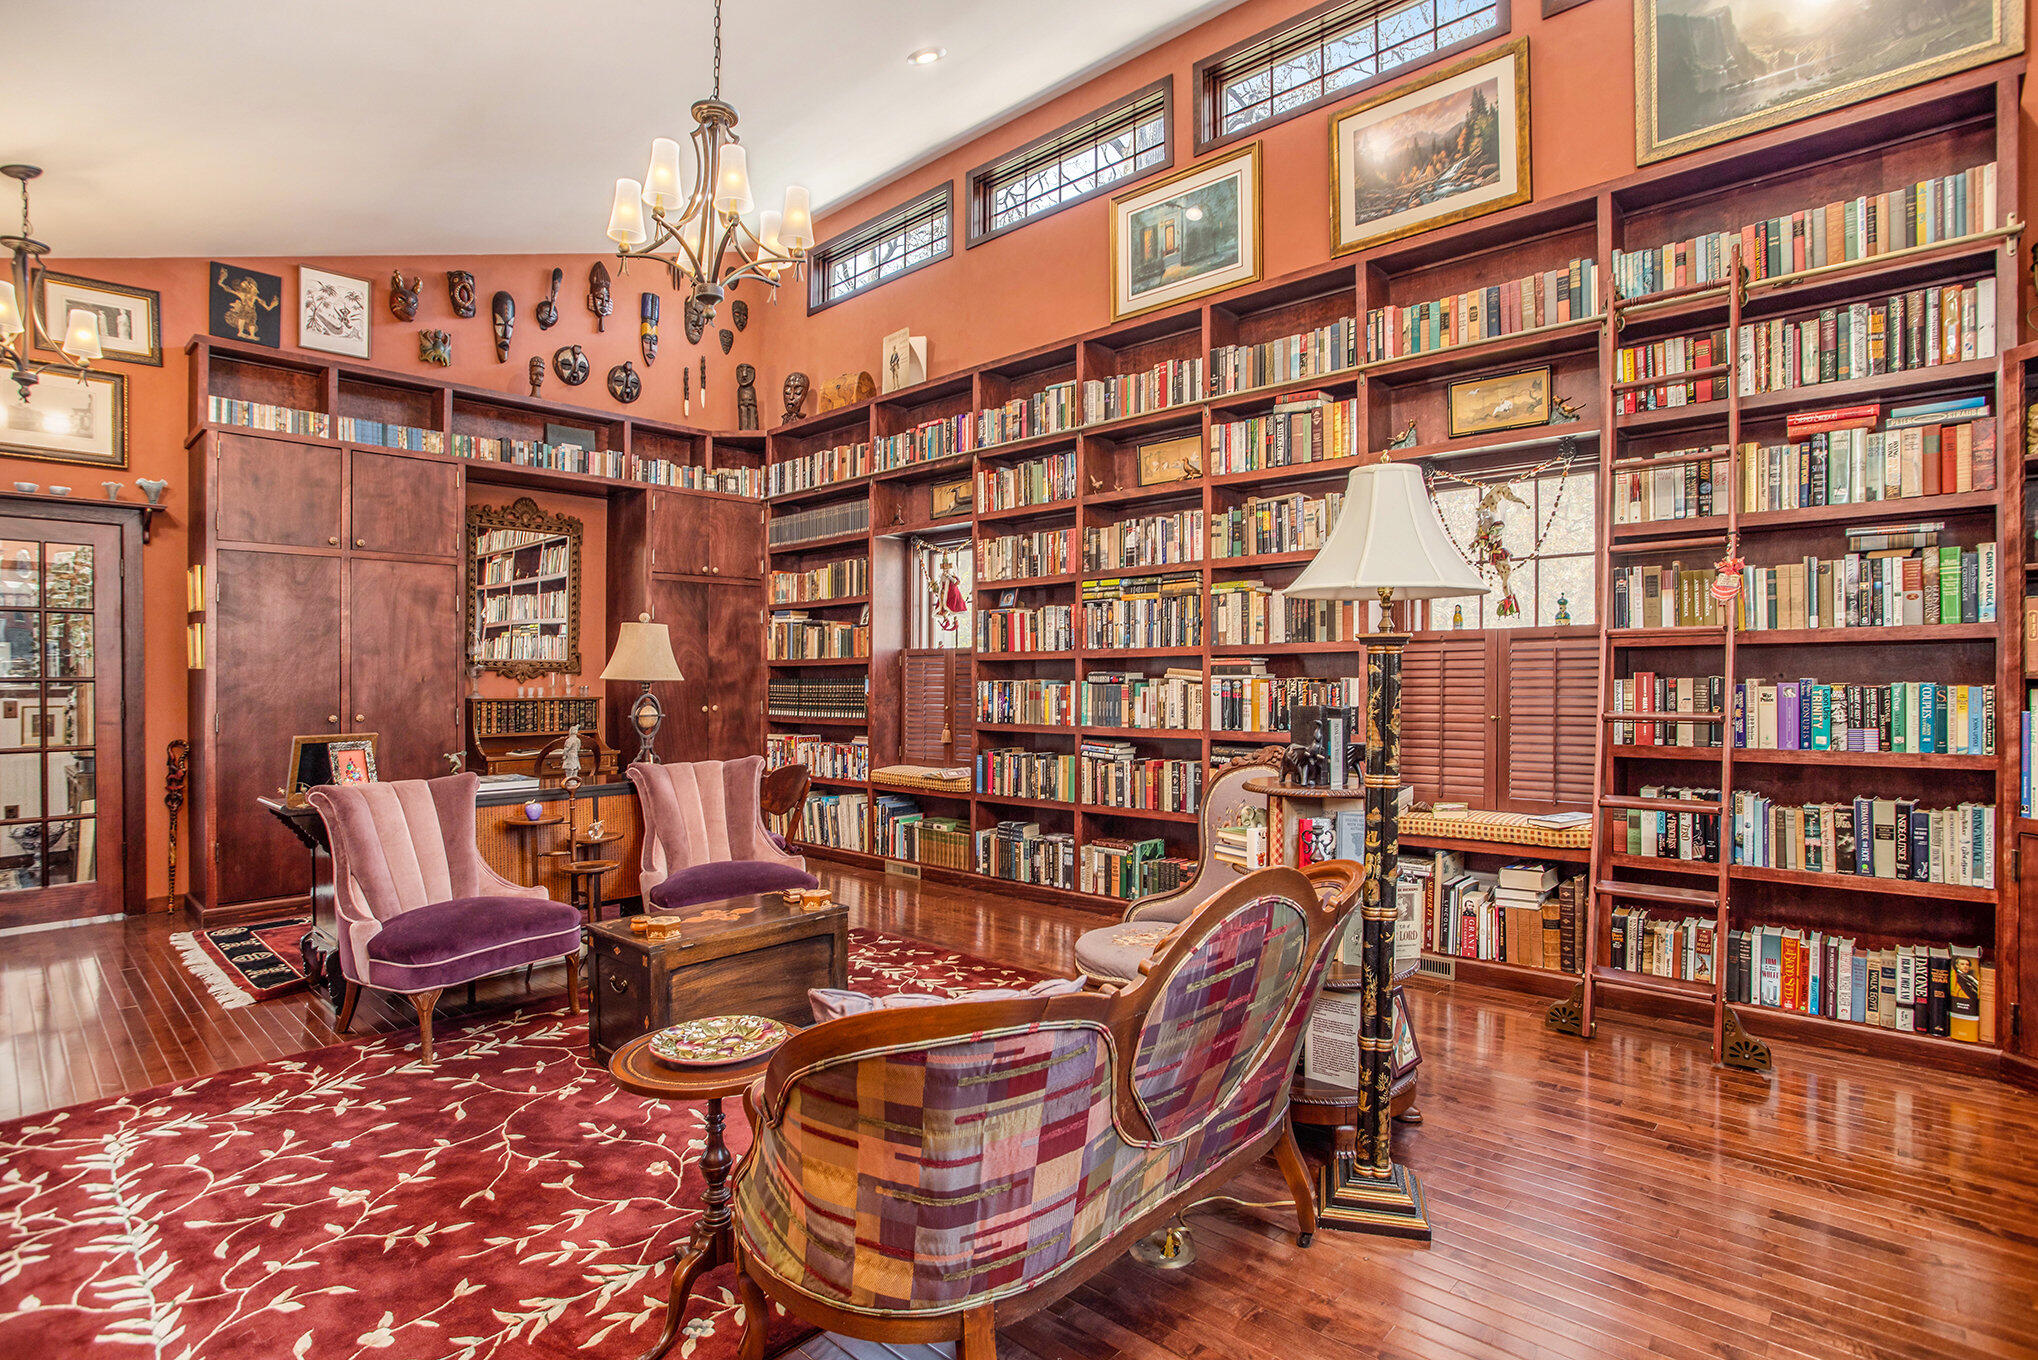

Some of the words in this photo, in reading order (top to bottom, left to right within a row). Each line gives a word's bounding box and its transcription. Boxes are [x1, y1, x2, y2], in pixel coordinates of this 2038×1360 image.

[1891, 418, 1912, 426] PETER
[1813, 690, 1822, 729] TRINITY
[1922, 687, 1932, 719] COUPLES
[1898, 814, 1906, 833] INSIDE
[1973, 810, 1982, 832] IRVING
[1681, 824, 1691, 841] ZERO
[1898, 834, 1906, 860] OUTSIDE
[1973, 835, 1982, 863] WALLACE
[1399, 931, 1417, 941] LORD
[1916, 958, 1928, 973] DAY
[1916, 976, 1928, 996] ONE
